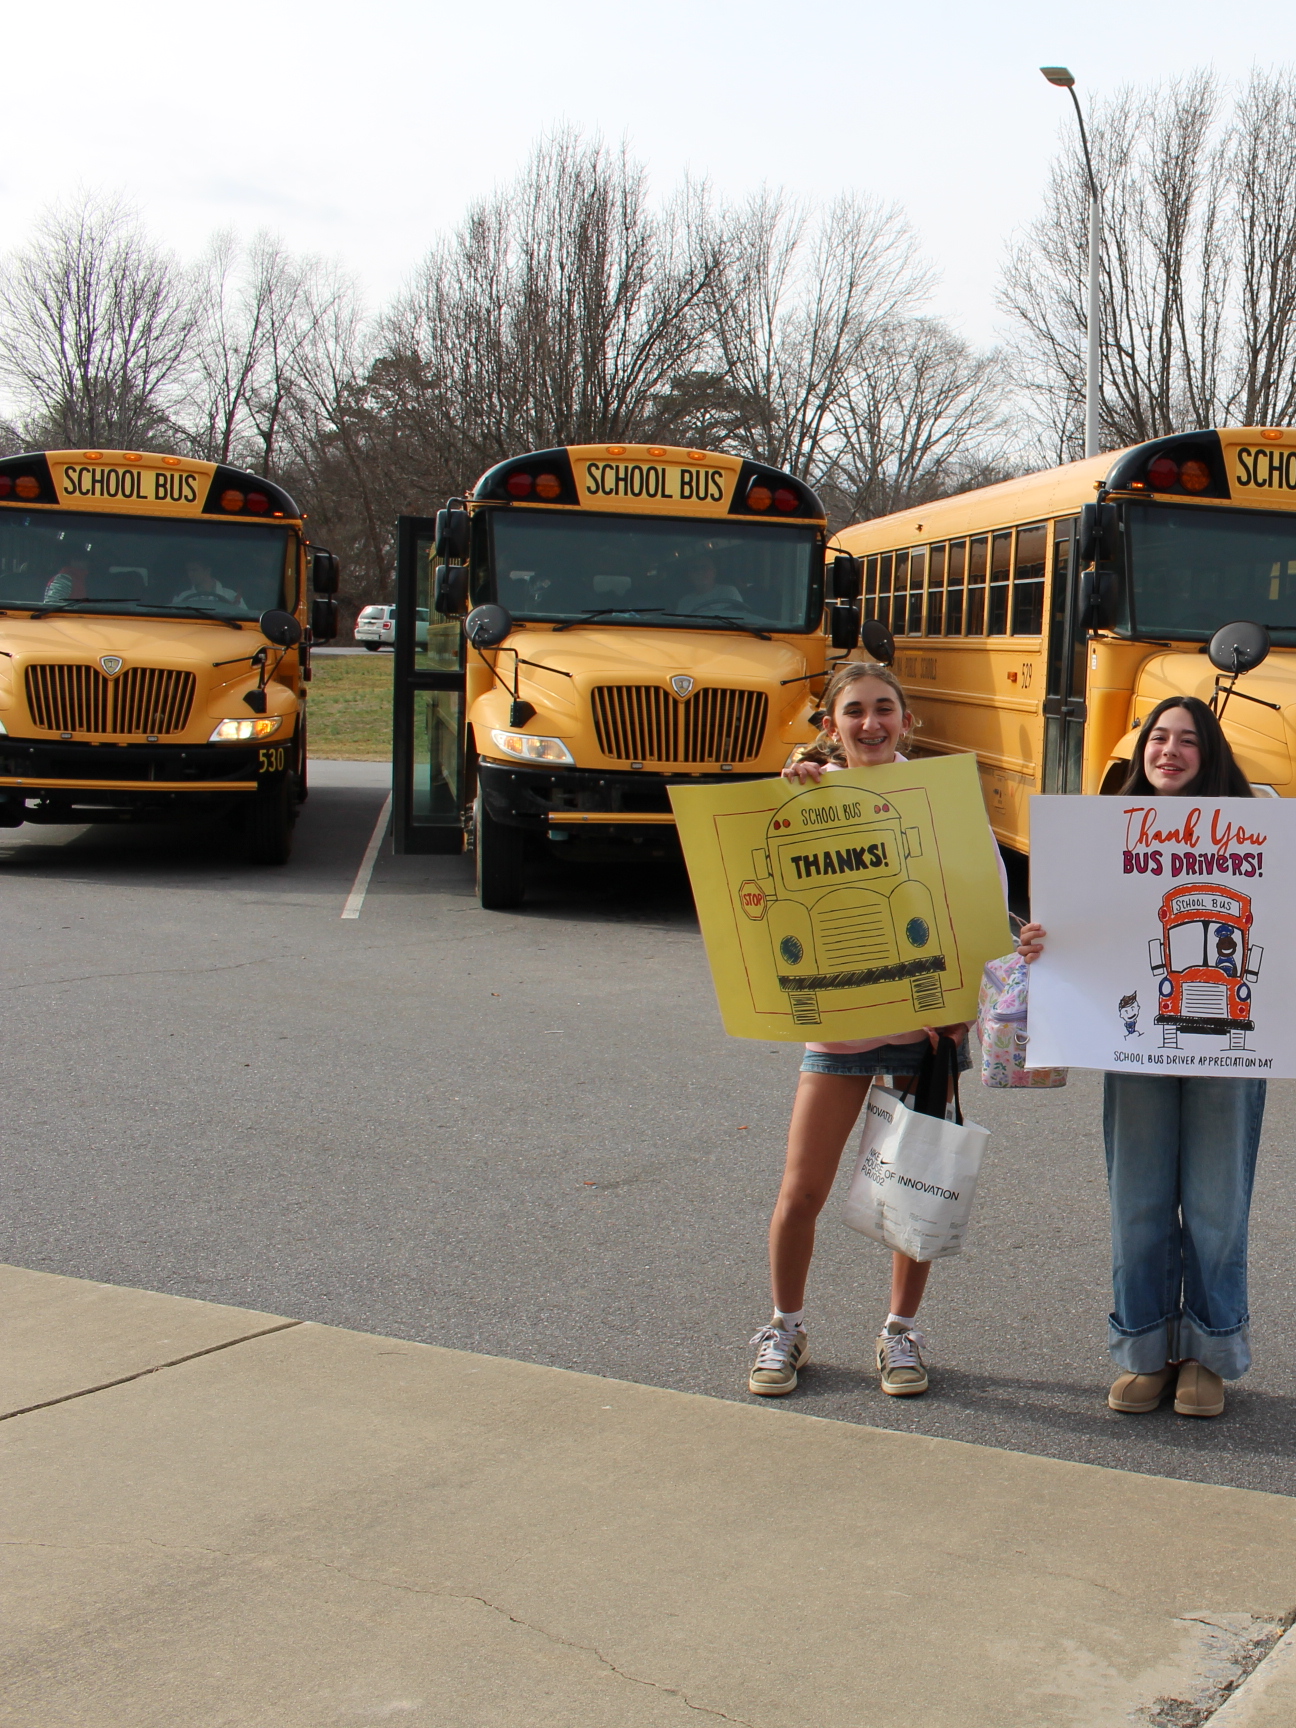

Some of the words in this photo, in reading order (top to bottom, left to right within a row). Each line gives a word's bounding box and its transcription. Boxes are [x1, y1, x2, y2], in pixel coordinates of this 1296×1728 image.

[63, 465, 148, 500] SCHOOL
[154, 472, 197, 503] BUS
[586, 462, 673, 499] SCHOOL
[680, 468, 724, 502] BUS
[1021, 663, 1033, 689] 529
[259, 748, 284, 772] 530
[801, 806, 841, 826] SCHOOL
[843, 802, 862, 821] BUS
[1123, 807, 1200, 852] Thank
[1209, 808, 1268, 856] You
[790, 842, 889, 879] THANKS!
[1123, 850, 1163, 876] BUS
[743, 893, 763, 907] STOP
[1175, 898, 1207, 911] SCHOOL
[1211, 898, 1232, 911] BUS
[1113, 1050, 1145, 1065] SCHOOL
[1147, 1054, 1164, 1064] BUS
[1166, 1054, 1196, 1066] DRIVER
[1198, 1055, 1257, 1068] APPRECIATION
[1257, 1058, 1274, 1069] DAY
[869, 1147, 882, 1161] NIKE
[864, 1156, 884, 1175] HOUSE
[884, 1169, 896, 1180] OF
[897, 1175, 960, 1201] INNOVATION
